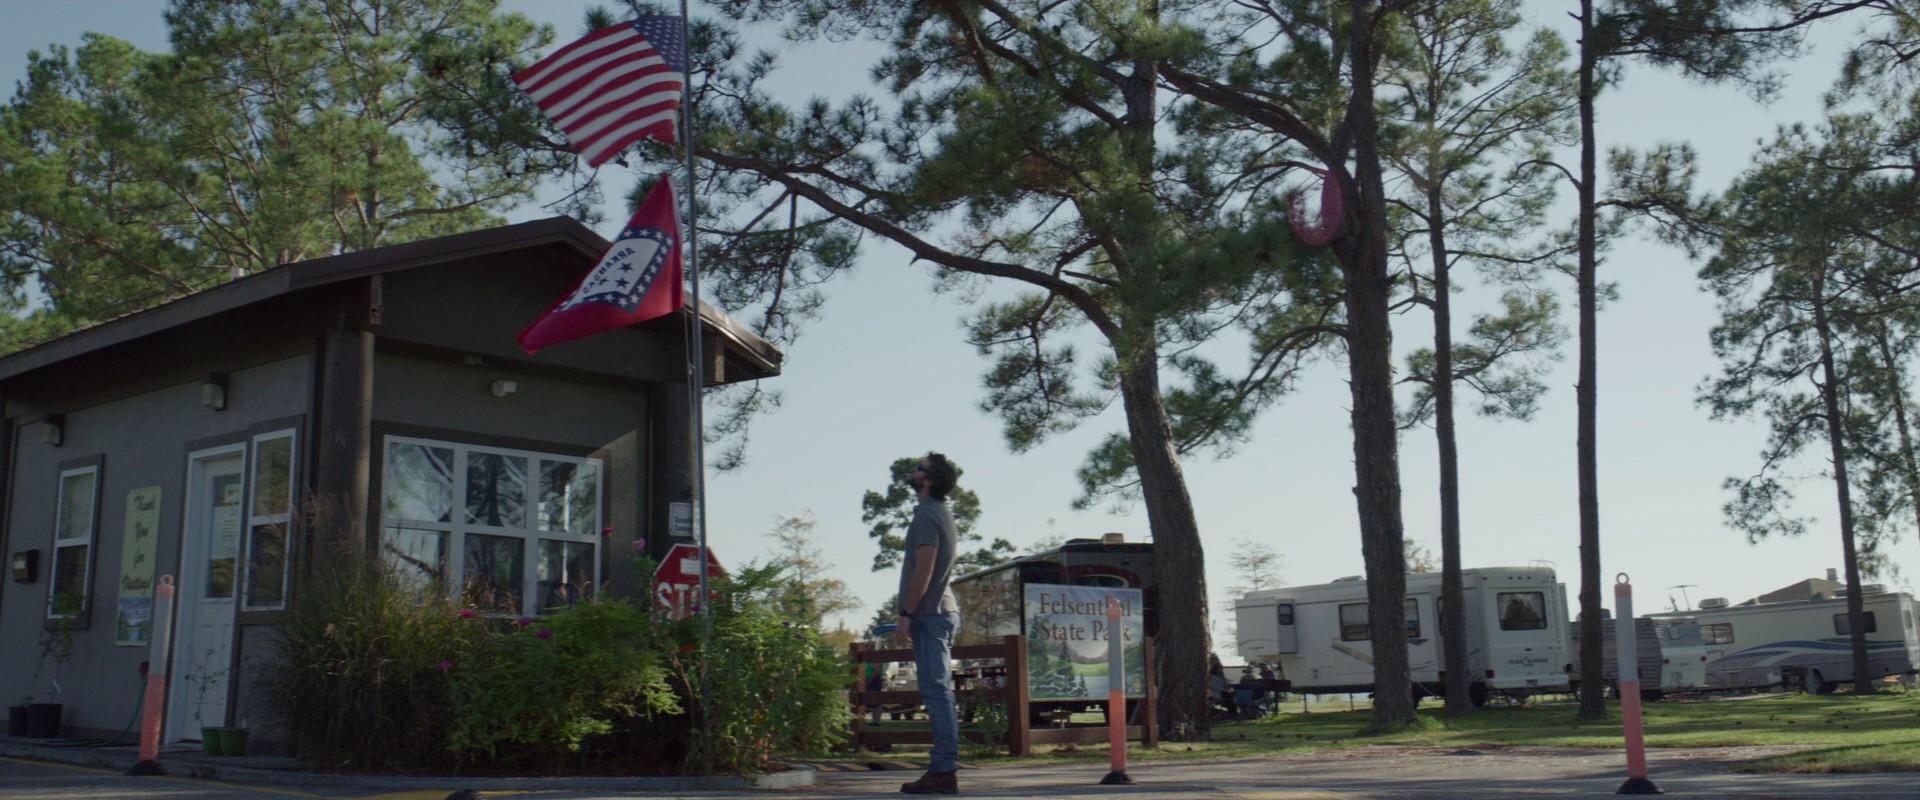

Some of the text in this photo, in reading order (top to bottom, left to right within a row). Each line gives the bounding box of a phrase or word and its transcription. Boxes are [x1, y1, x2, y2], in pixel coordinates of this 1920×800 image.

[657, 582, 709, 620] ST
[1039, 619, 1131, 641] State Pak
